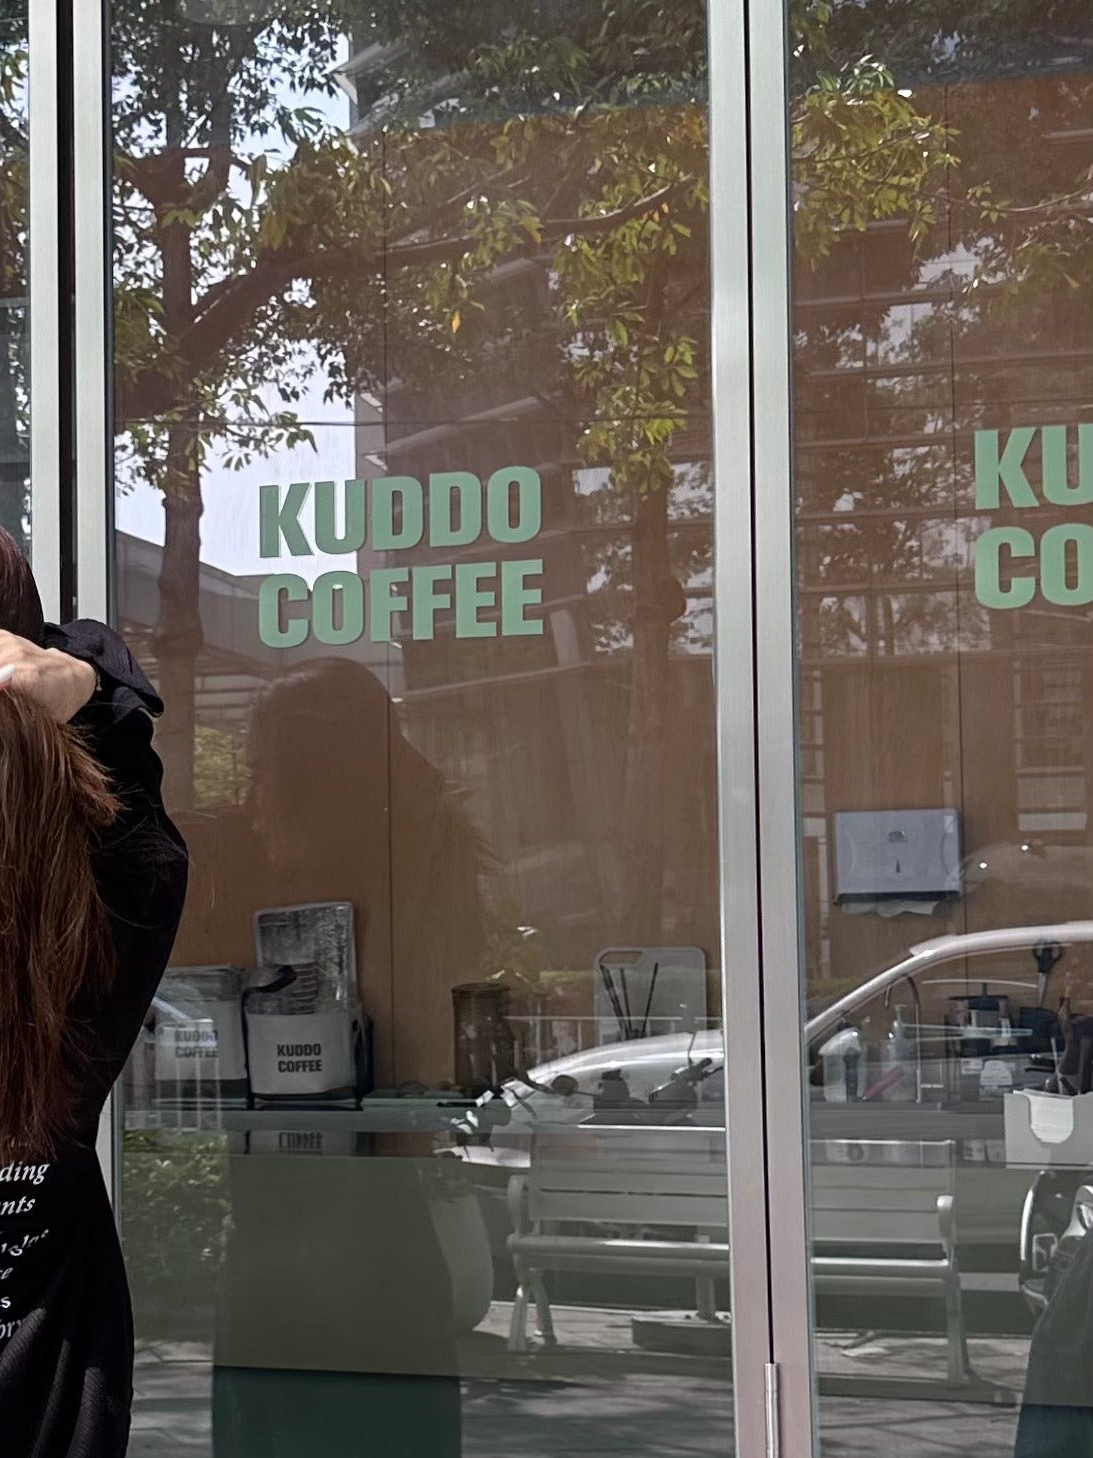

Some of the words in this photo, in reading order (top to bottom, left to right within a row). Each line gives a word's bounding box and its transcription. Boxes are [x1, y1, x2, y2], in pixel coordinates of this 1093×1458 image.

[259, 466, 541, 558] KUDDO
[258, 559, 543, 649] COFFEE
[277, 1044, 322, 1057] KUDDO
[278, 1060, 323, 1073] COFFEE
